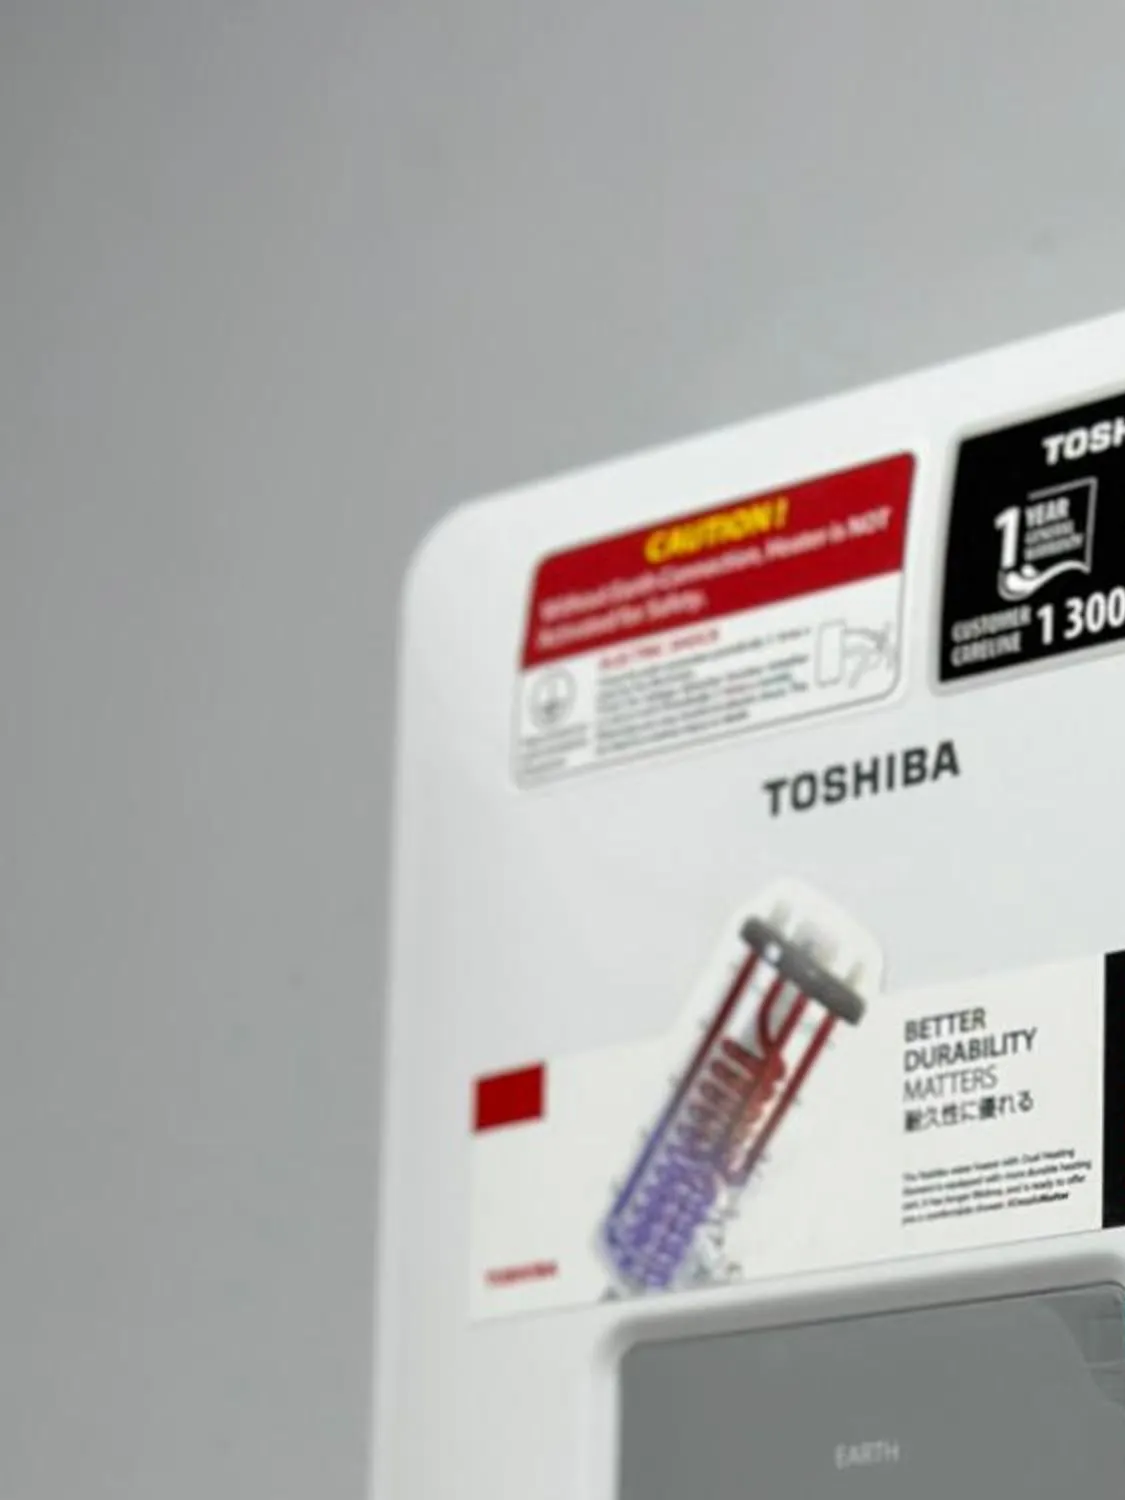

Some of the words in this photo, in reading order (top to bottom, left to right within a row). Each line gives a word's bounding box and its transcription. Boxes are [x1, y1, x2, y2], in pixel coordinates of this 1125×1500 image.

[994, 506, 1021, 570] 1
[1025, 497, 1070, 528] YEAR
[951, 605, 1032, 643] CUSTOMER
[1036, 604, 1054, 645] 1
[950, 631, 1022, 667] CARELINE
[762, 739, 960, 818] TOSHIBA
[904, 1006, 986, 1044] BETTER
[904, 1026, 1037, 1073] DURABILITY
[904, 1063, 998, 1101] MATTERS
[835, 1440, 900, 1470] EARTH
